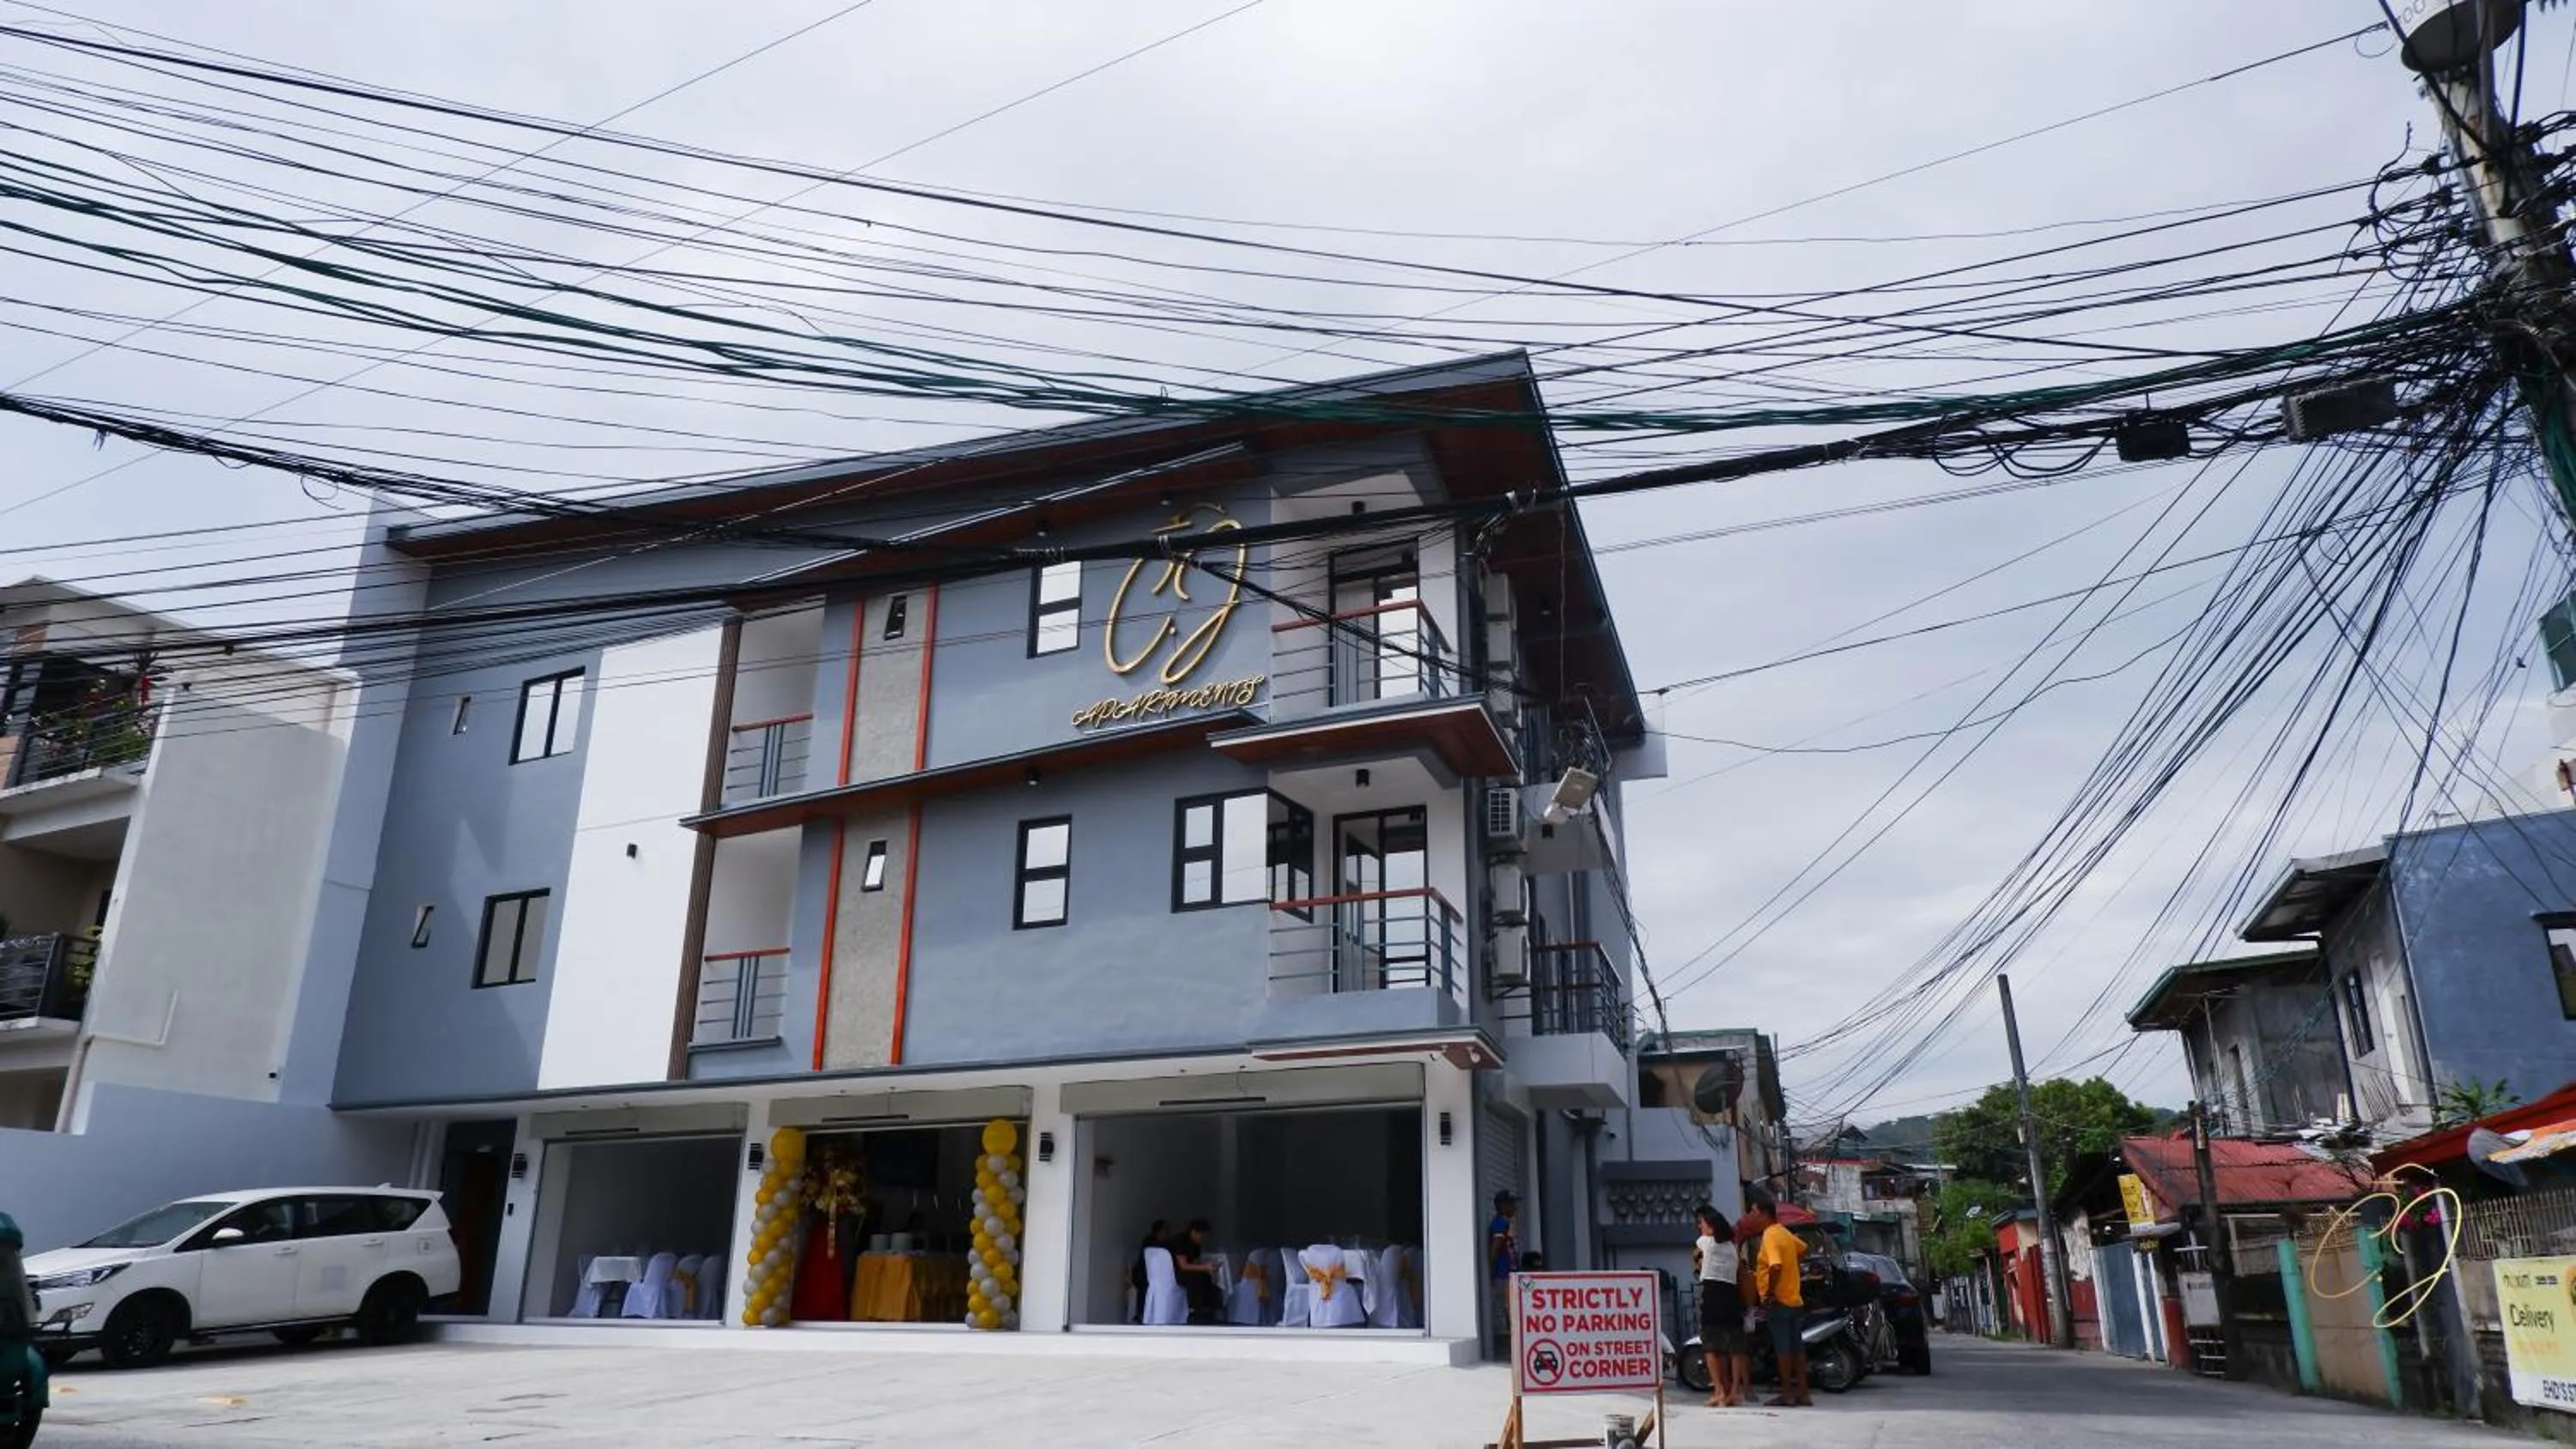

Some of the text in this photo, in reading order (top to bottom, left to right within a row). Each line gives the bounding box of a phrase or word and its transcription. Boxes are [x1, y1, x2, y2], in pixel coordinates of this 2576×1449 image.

[1531, 1288, 1643, 1310] STRICTLY
[1526, 1313, 1650, 1332] NO PARKING
[2509, 1303, 2555, 1332] Delivery
[1566, 1340, 1651, 1356] ON STREET
[1569, 1359, 1650, 1379] CORNER
